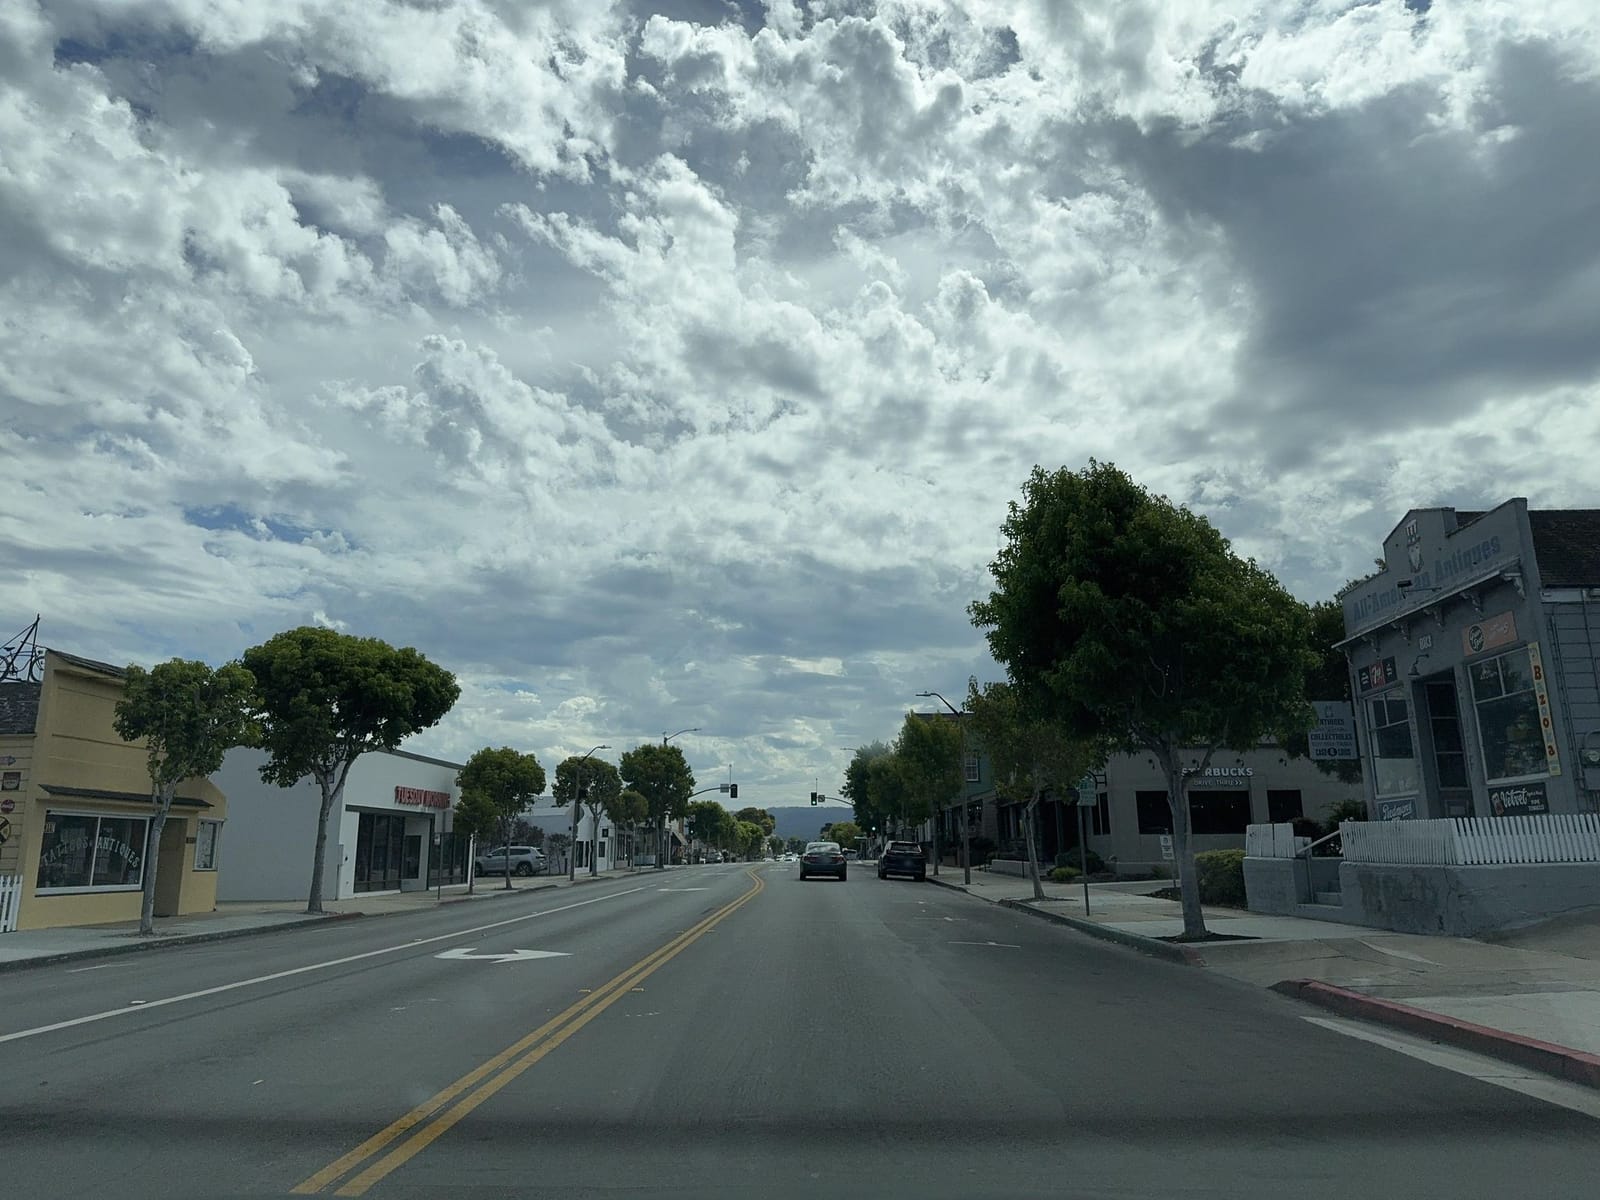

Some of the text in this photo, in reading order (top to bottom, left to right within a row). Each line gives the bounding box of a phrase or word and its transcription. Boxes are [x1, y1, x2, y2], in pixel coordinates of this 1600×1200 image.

[1353, 535, 1499, 622] All-Ameran Antiques
[1181, 767, 1253, 777] STRBUCKS
[97, 837, 140, 868] ANTIQUES
